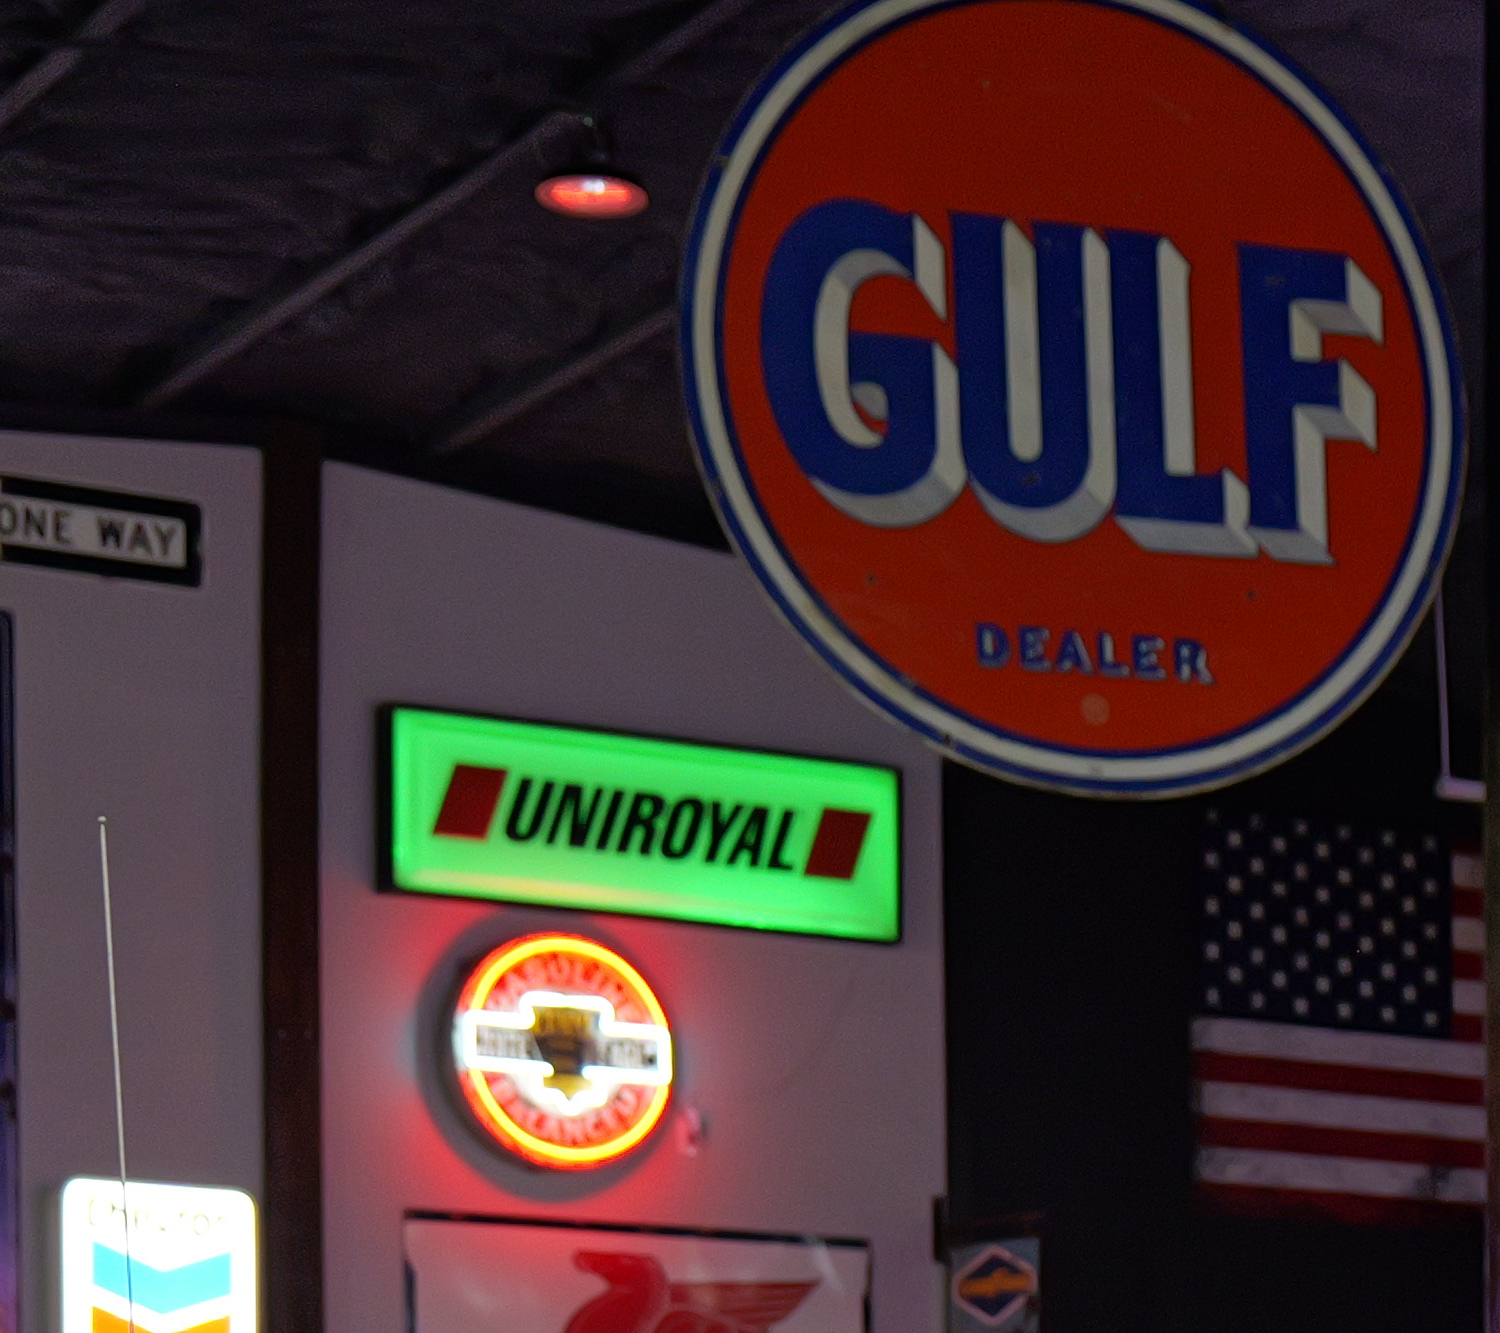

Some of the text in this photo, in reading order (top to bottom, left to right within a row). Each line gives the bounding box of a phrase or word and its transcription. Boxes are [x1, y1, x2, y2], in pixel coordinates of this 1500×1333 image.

[759, 197, 1385, 566] GULF
[98, 514, 179, 559] WAY
[972, 622, 1216, 685] DEALER
[505, 777, 803, 872] UNIROYAL
